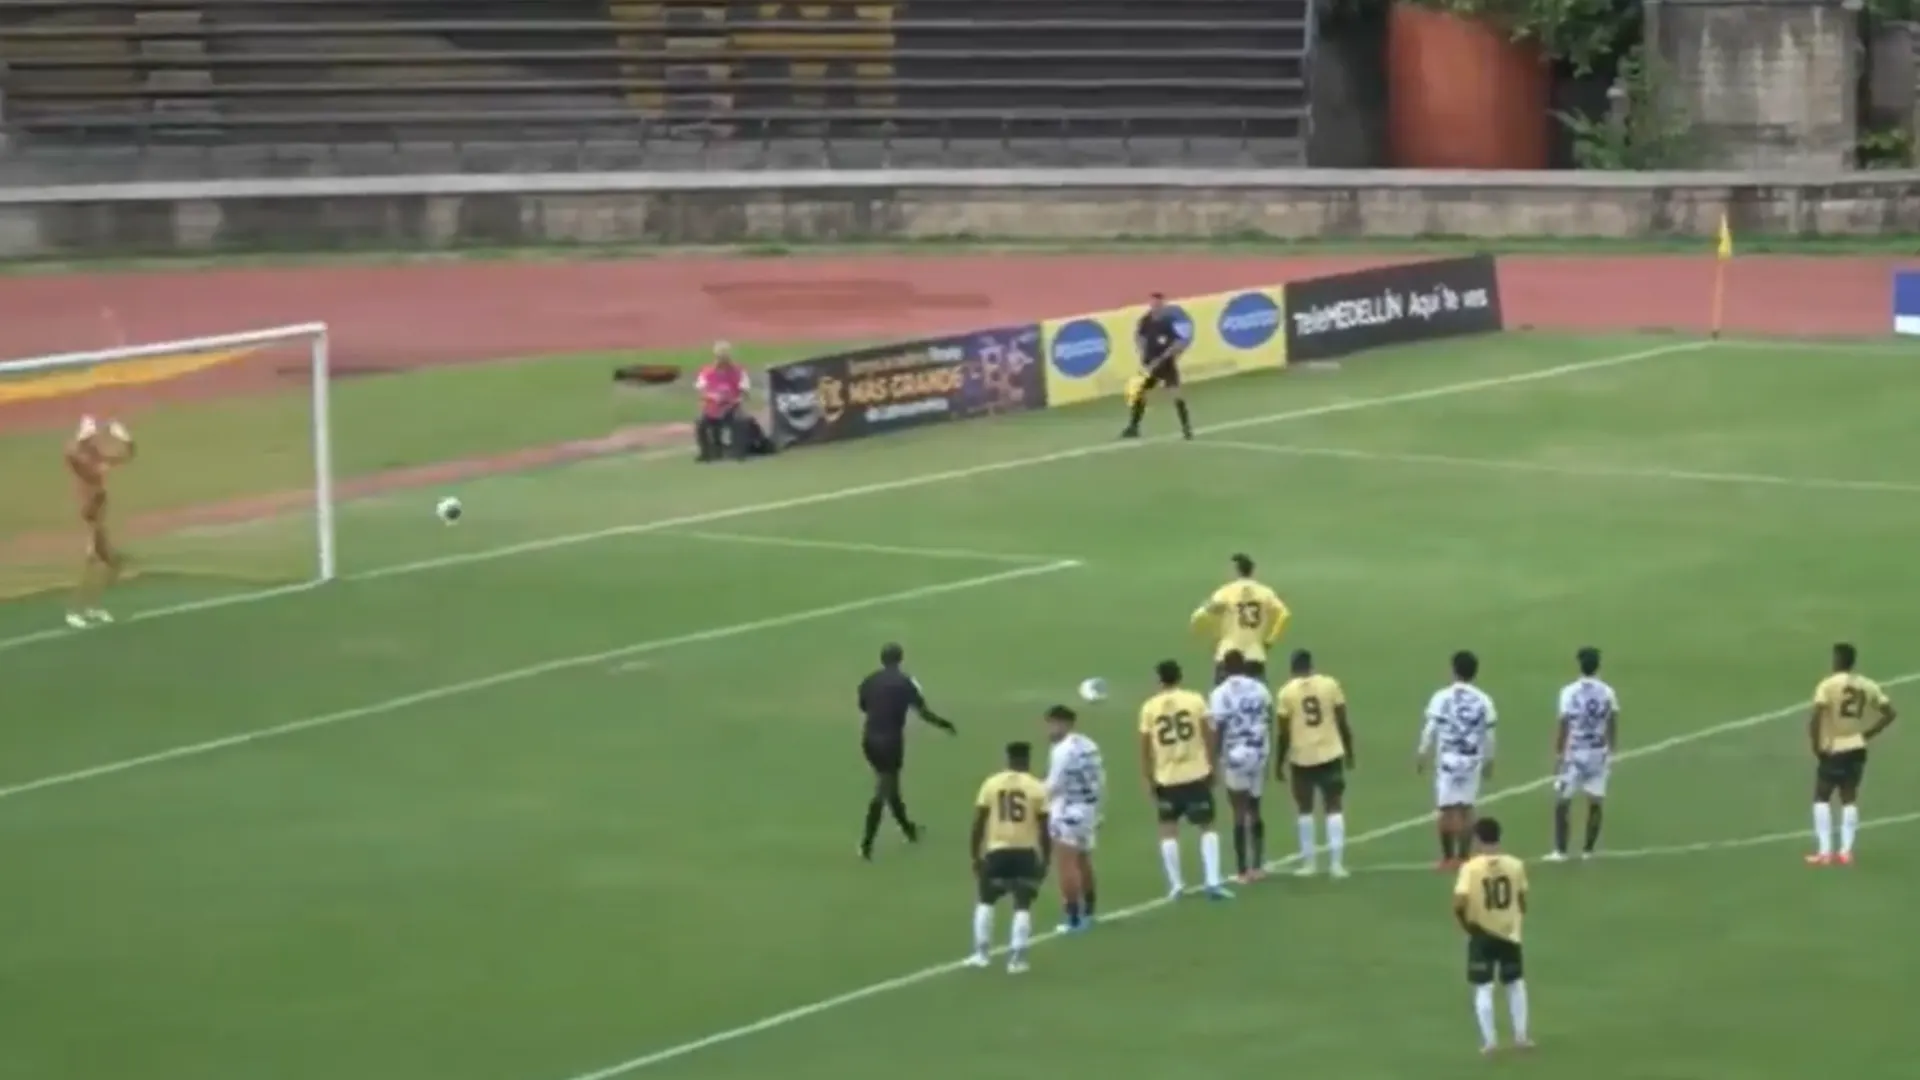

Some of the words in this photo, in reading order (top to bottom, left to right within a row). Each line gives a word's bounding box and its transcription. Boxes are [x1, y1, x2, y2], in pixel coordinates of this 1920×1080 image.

[1237, 601, 1261, 628] 13
[1302, 696, 1322, 727] 9
[1841, 686, 1867, 719] 21
[1155, 710, 1194, 746] 26
[998, 789, 1026, 823] 16
[1482, 874, 1512, 911] 10
